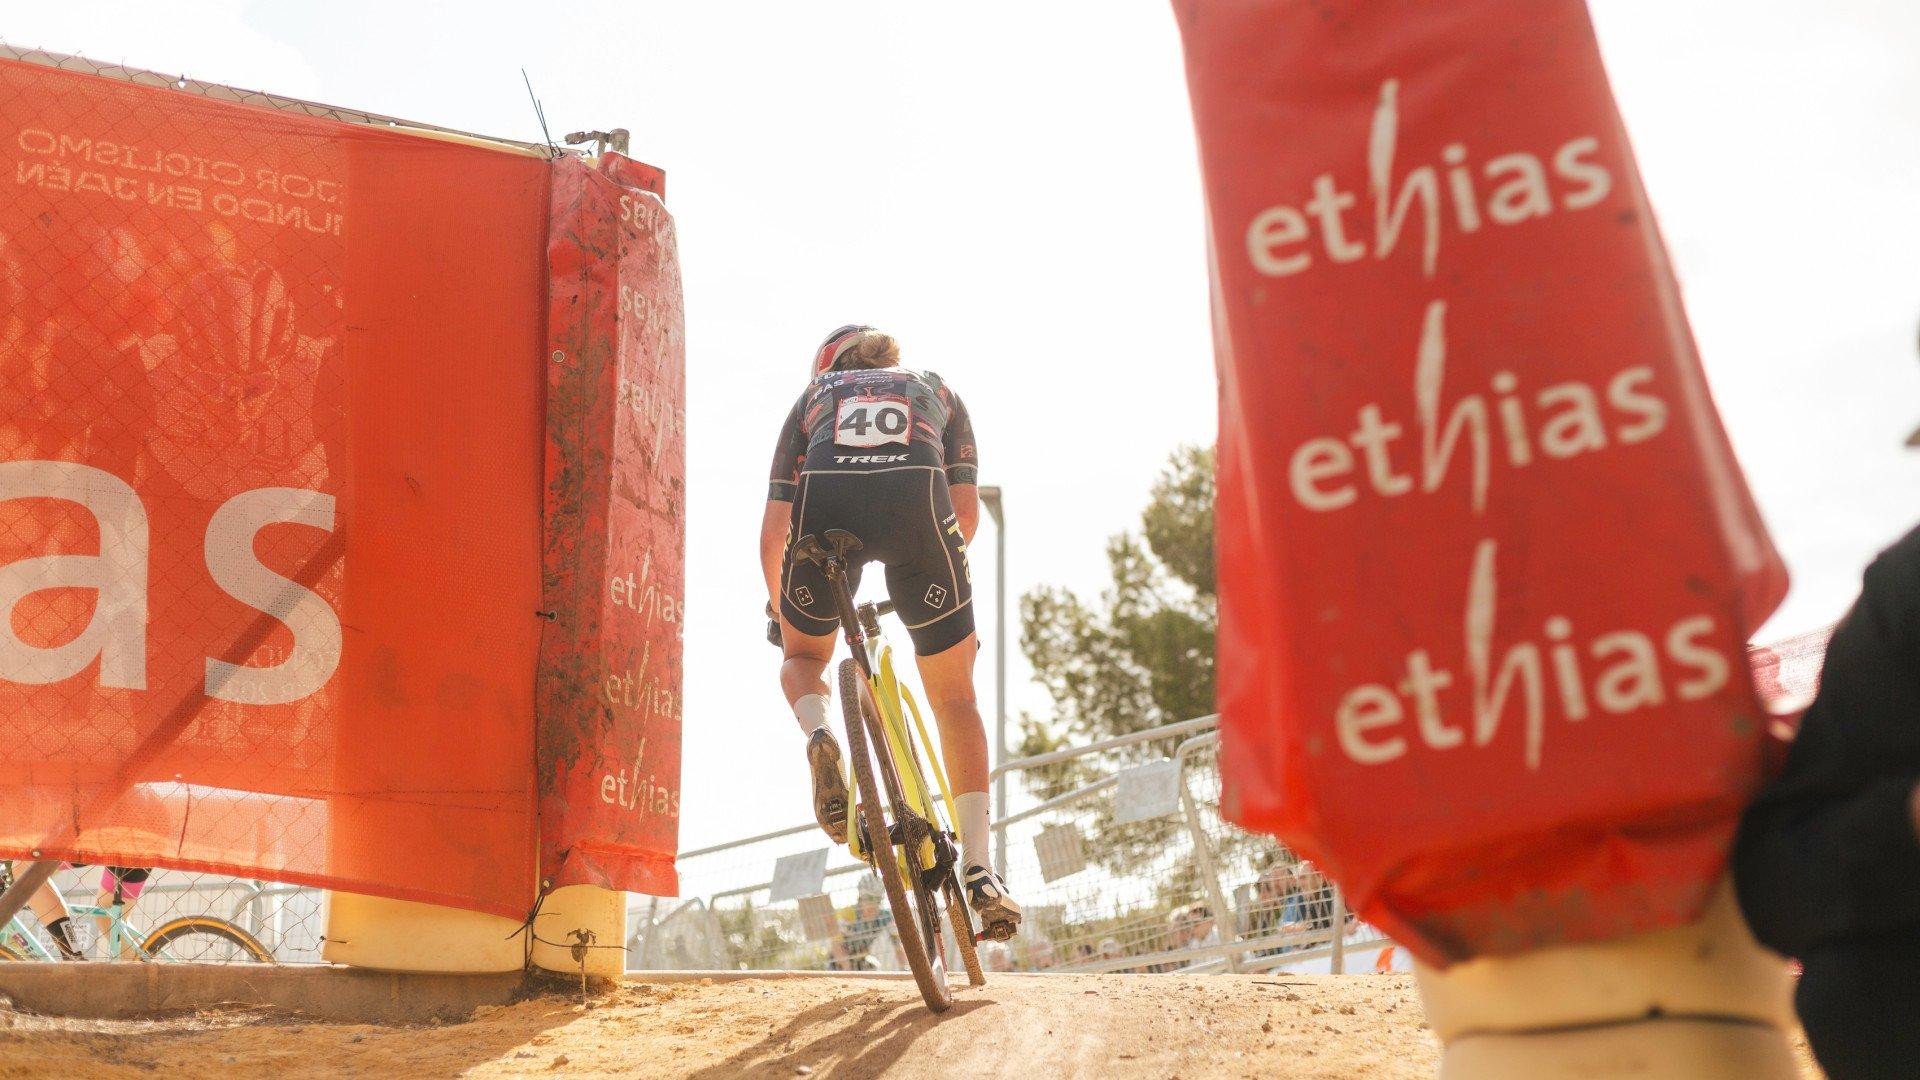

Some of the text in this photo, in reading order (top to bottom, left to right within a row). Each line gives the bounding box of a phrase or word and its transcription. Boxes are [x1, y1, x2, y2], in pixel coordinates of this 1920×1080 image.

[1244, 79, 1612, 278] ethias
[833, 453, 910, 464] TREK
[837, 407, 908, 436] 40
[1288, 301, 1669, 514] ethias
[1334, 540, 1731, 770] ethias
[601, 737, 680, 823] ethias
